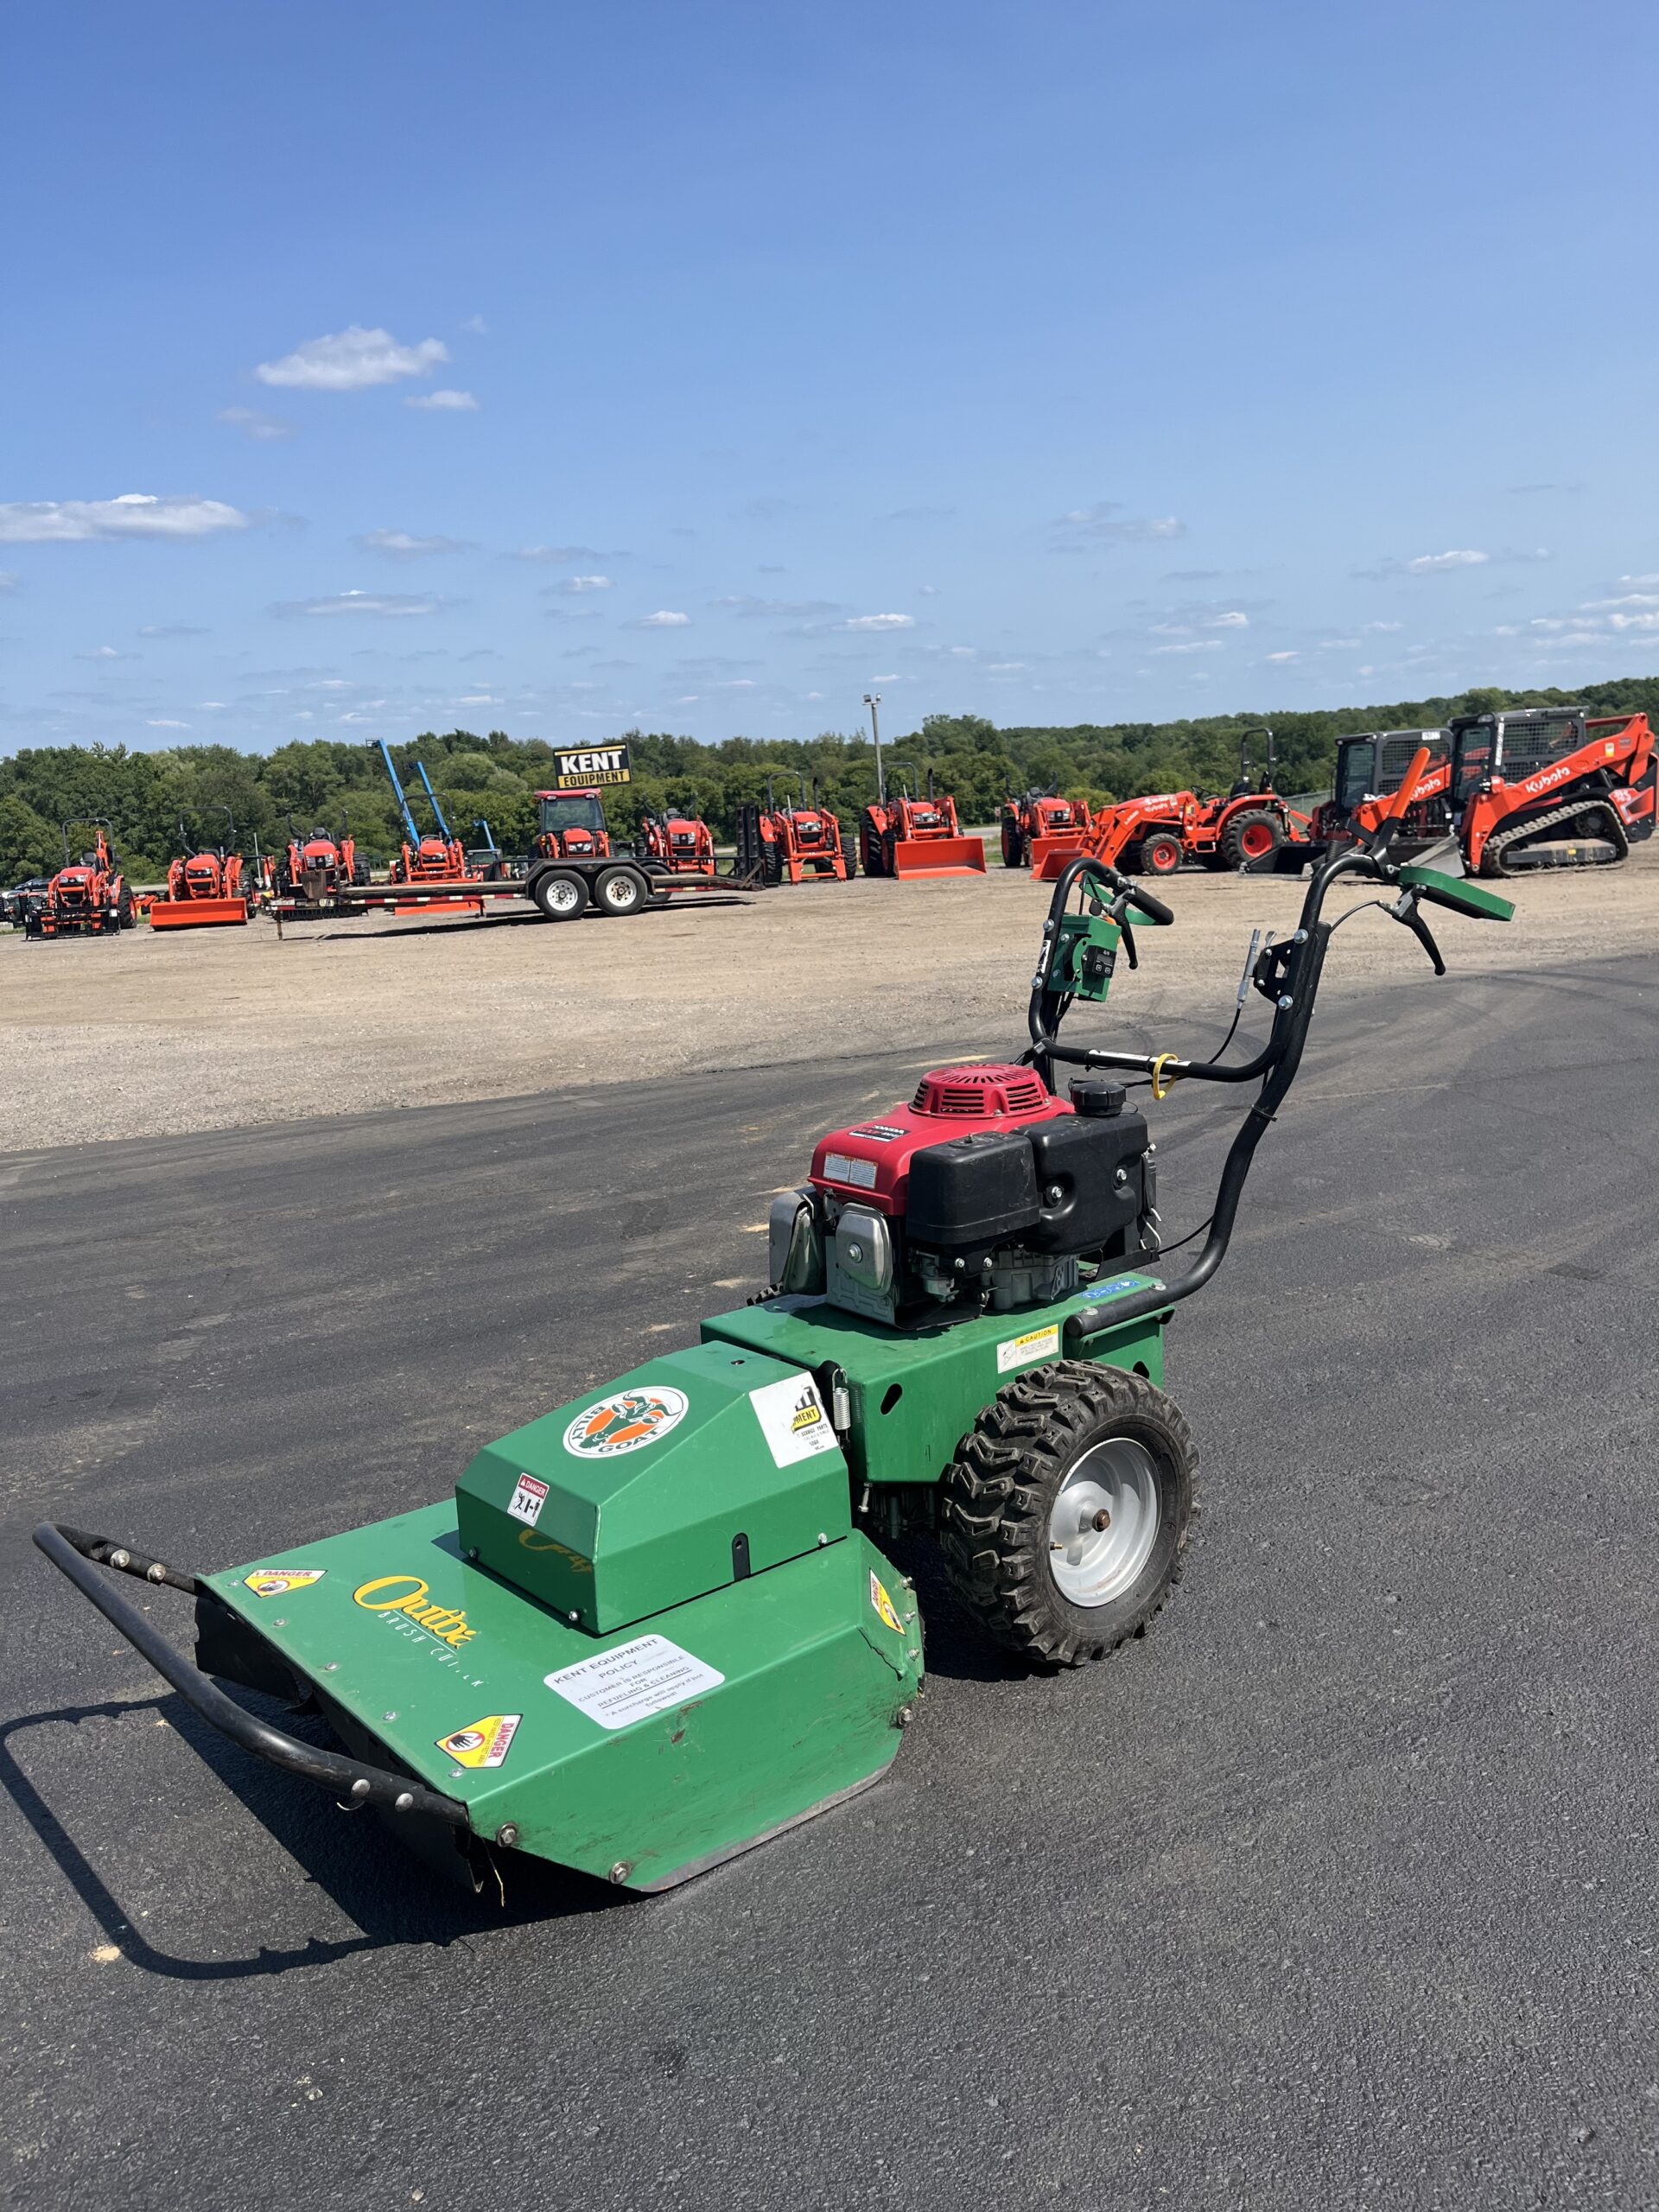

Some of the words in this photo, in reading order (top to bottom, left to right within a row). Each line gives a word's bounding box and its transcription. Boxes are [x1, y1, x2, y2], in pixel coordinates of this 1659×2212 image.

[560, 750, 622, 775] KENT
[563, 771, 625, 787] EQUIPMENT
[1409, 779, 1441, 801] ubota
[1525, 766, 1571, 793] Kubota
[1025, 1329, 1052, 1343] CAUTION
[571, 1406, 607, 1440] BILLY
[598, 1427, 659, 1452] GOAT
[525, 1480, 546, 1497] DANGER
[378, 1611, 427, 1643] BRUSH
[554, 1667, 588, 1684] KENT
[589, 1638, 659, 1670] EQUIPMENT
[598, 1659, 639, 1679] POLICY
[578, 1681, 622, 1702] CUSTOMER
[631, 1655, 686, 1682] RESPONSIBLE
[597, 1685, 644, 1707] REFUELING
[650, 1666, 690, 1685] CLEANING
[629, 1677, 647, 1688] FOR
[617, 1694, 652, 1713] surcharge
[653, 1688, 665, 1698] will
[665, 1681, 685, 1693] apply
[488, 1722, 515, 1758] DANGER
